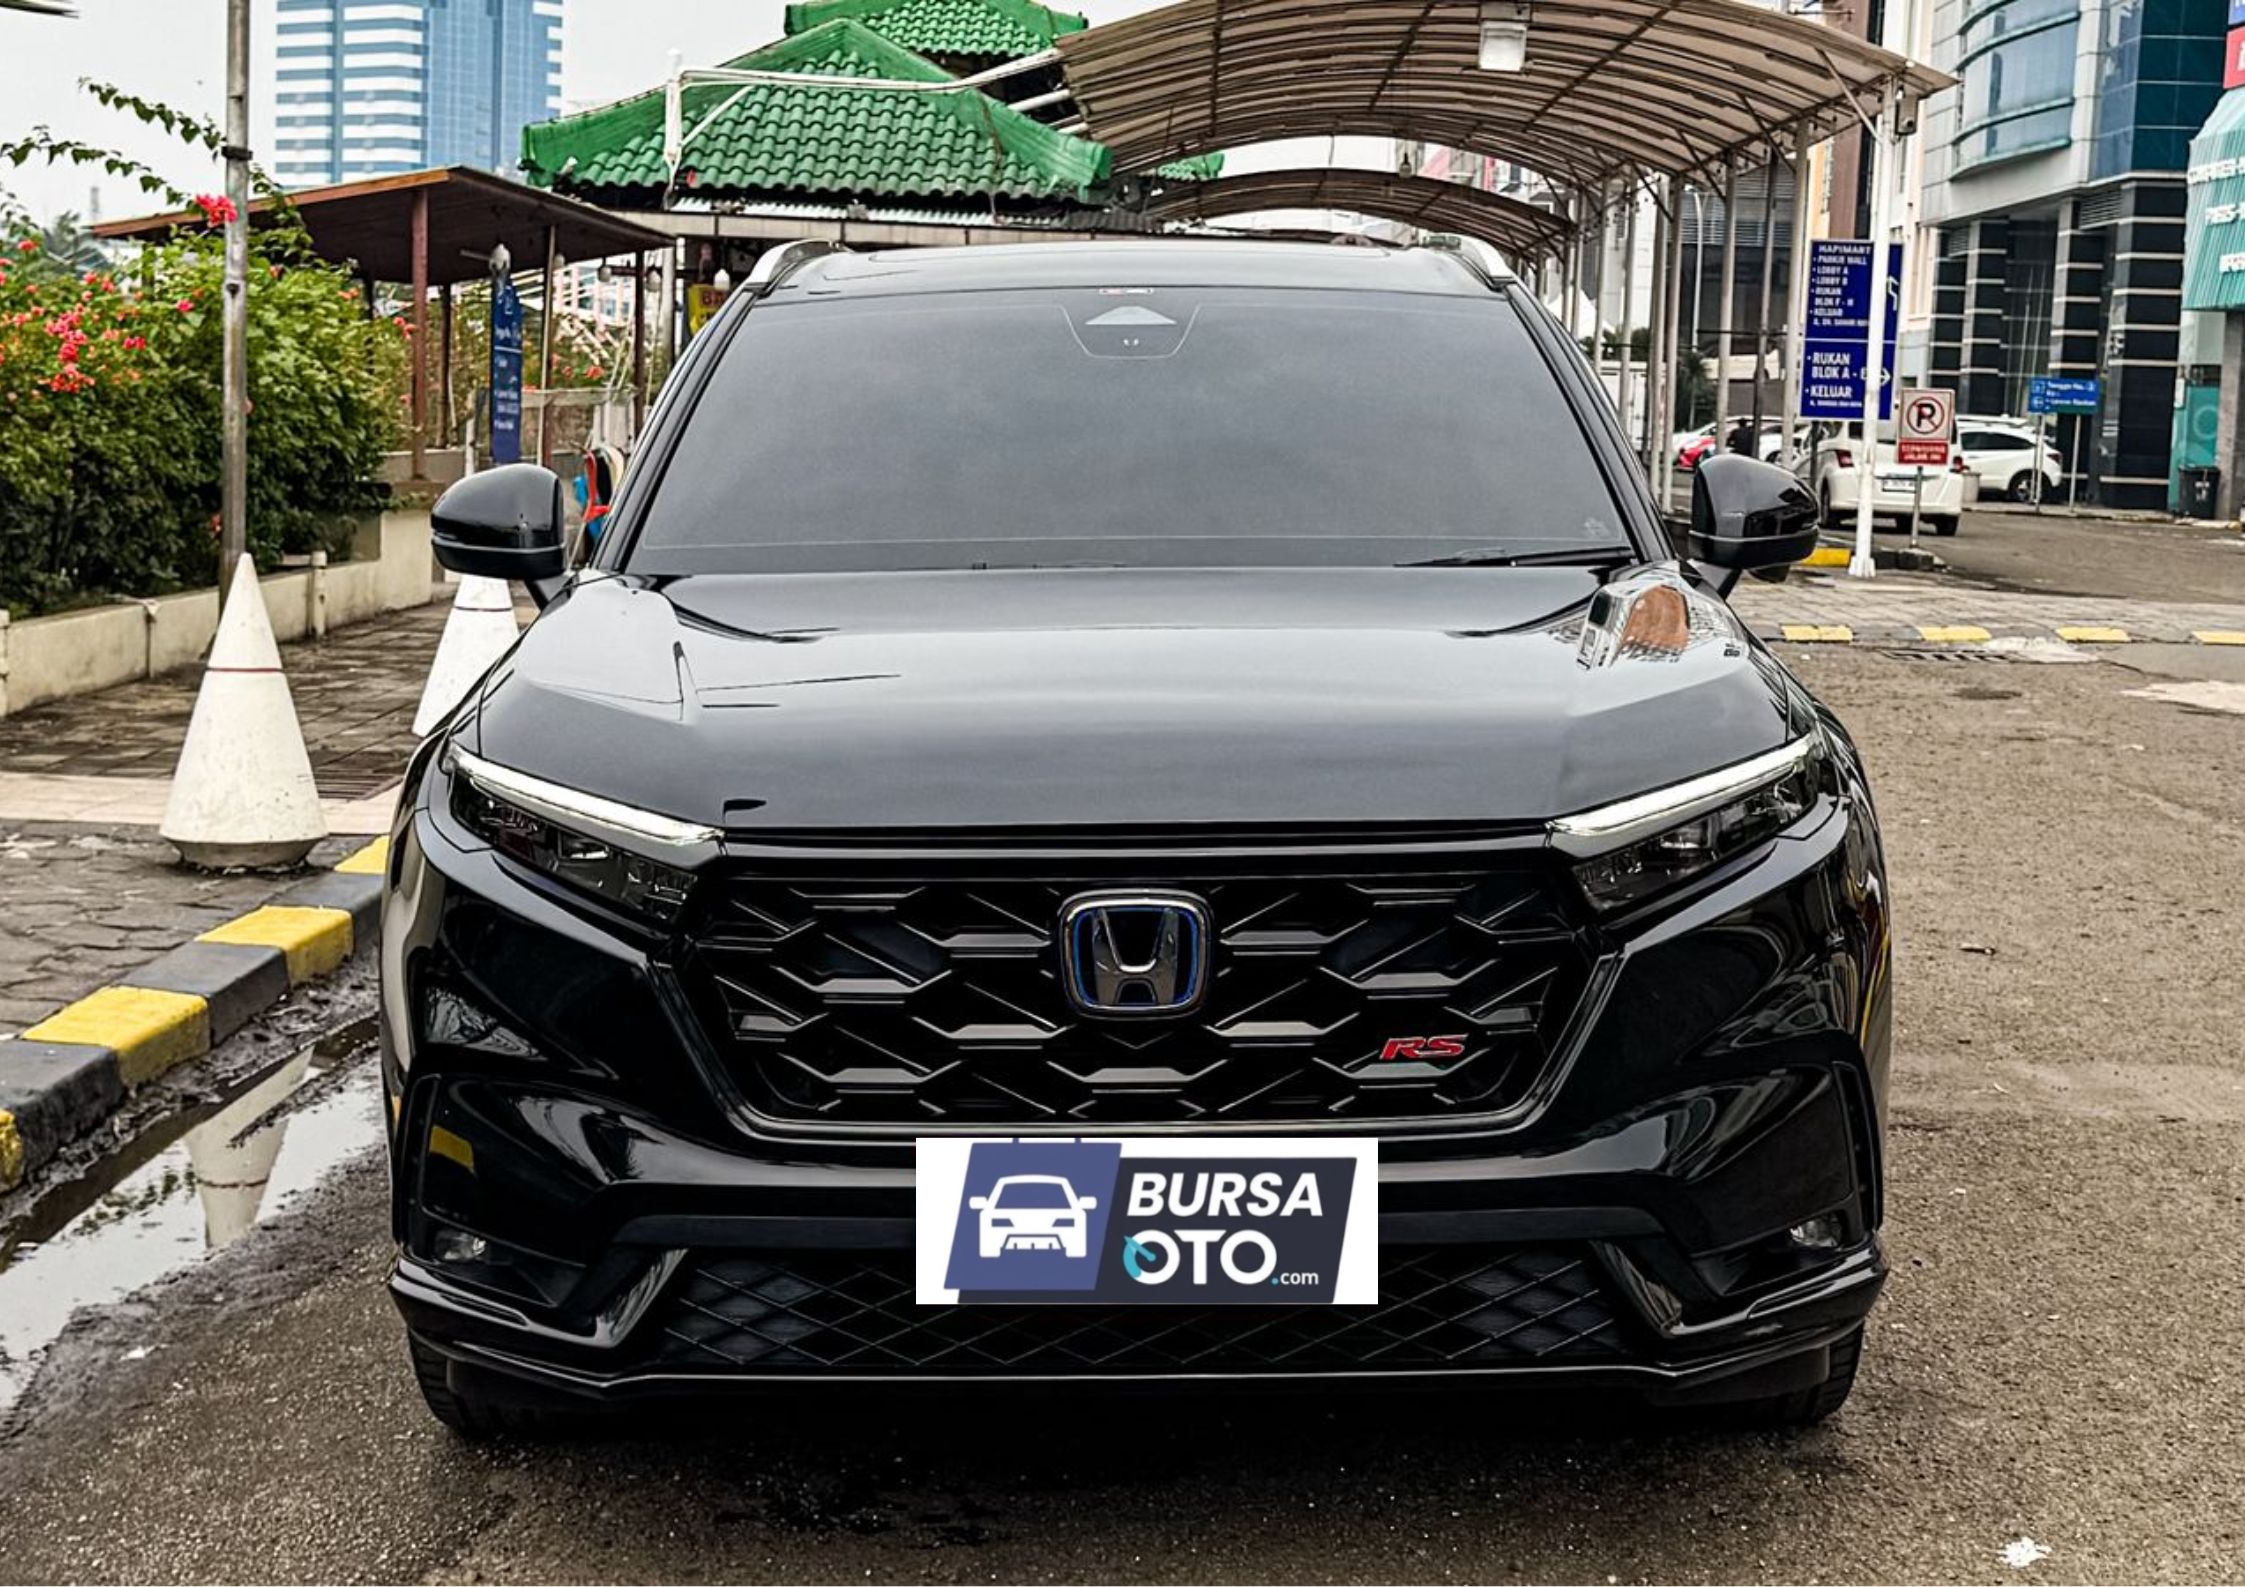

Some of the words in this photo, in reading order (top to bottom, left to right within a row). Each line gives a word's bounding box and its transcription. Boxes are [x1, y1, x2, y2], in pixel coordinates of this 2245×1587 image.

[1817, 266, 1841, 274] LOBBY
[1816, 276, 1840, 285] LOBBY
[1812, 352, 1850, 366] RUKAN
[1811, 366, 1840, 379] BLOK
[1842, 367, 1850, 379] A
[1810, 385, 1853, 399] KELUAR
[1379, 1033, 1469, 1060] RS
